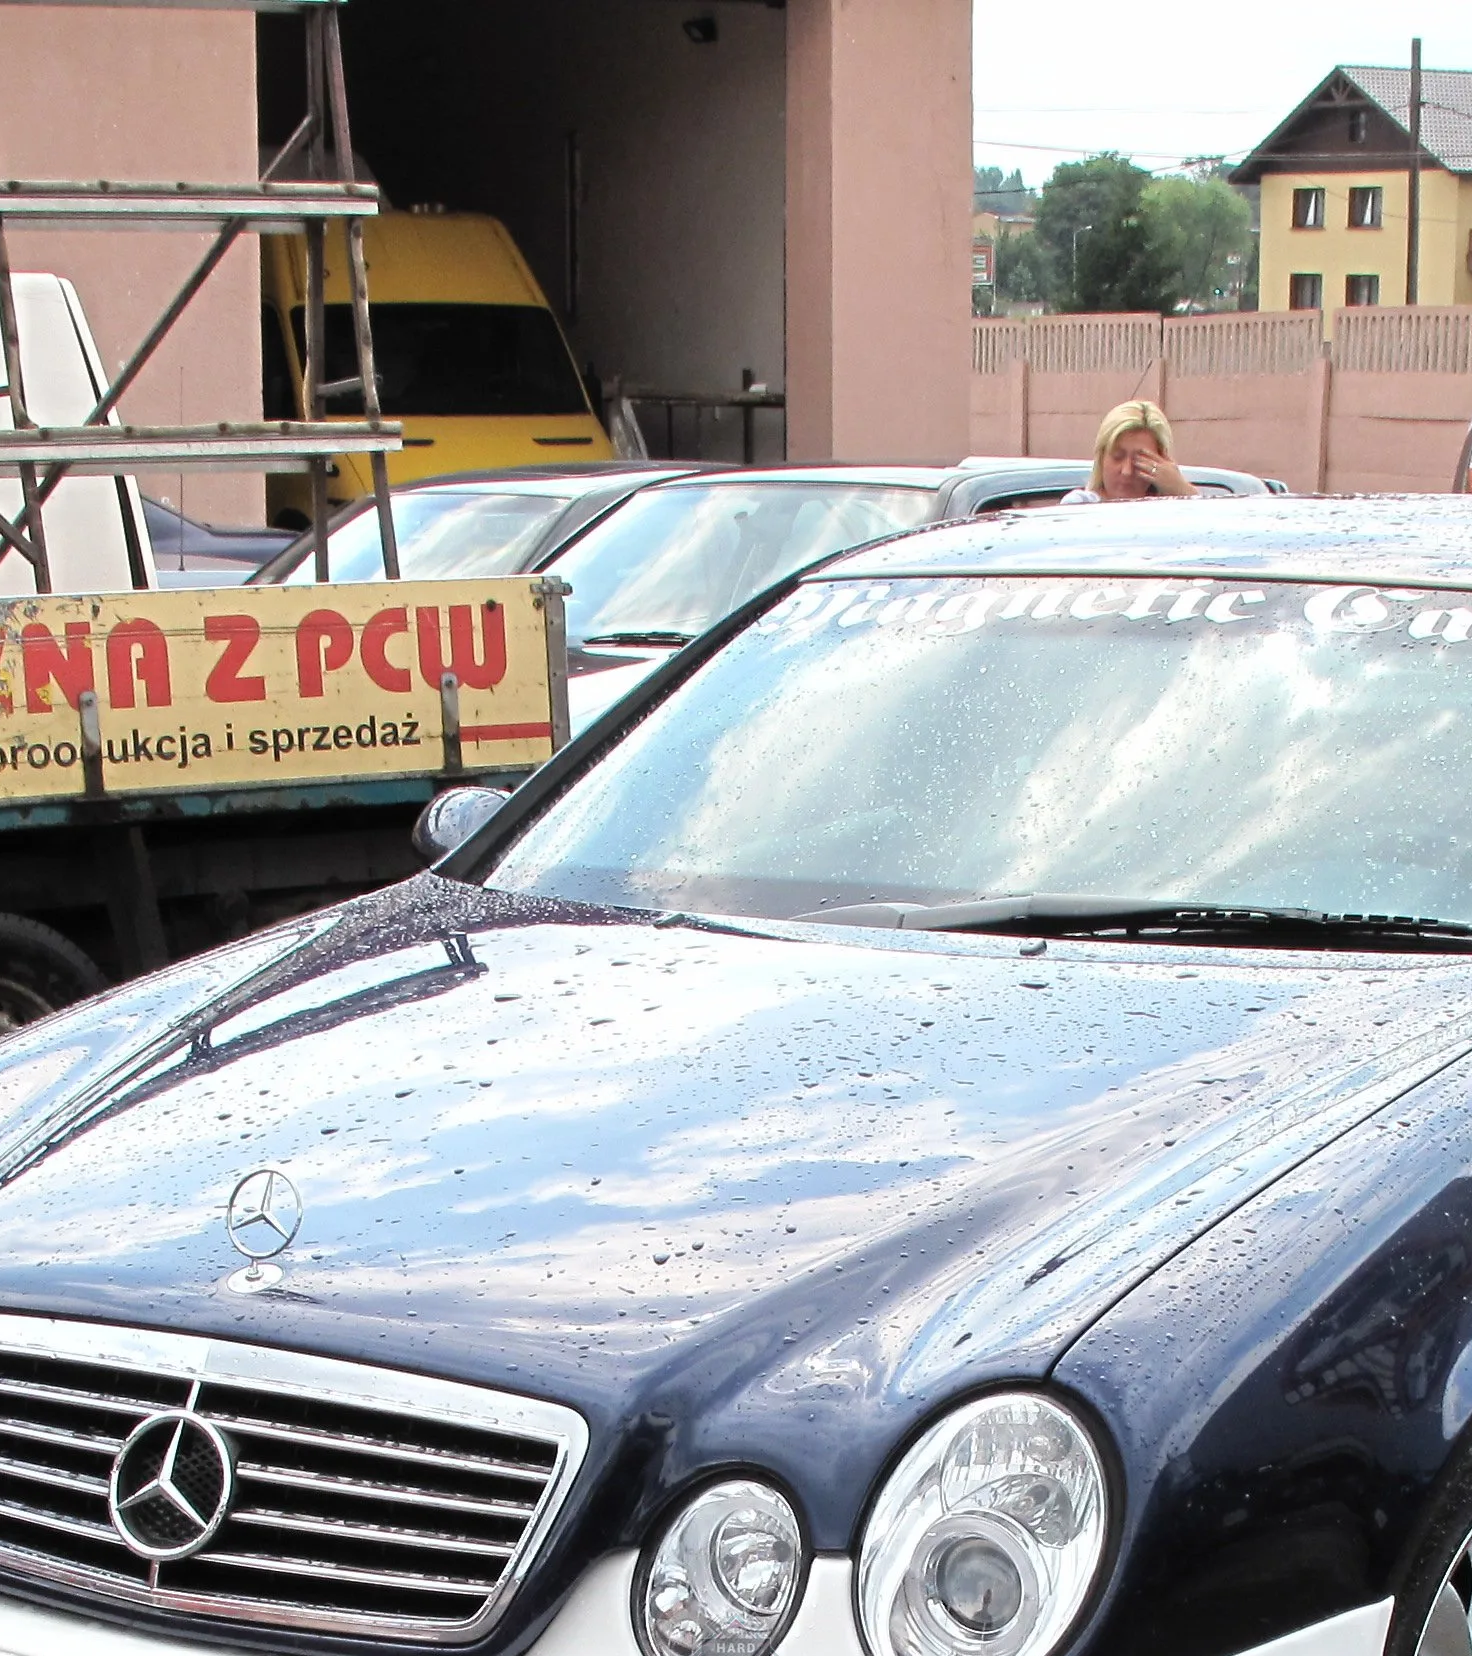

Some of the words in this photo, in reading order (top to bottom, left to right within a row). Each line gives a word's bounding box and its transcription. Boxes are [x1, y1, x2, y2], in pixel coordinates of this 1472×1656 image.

[202, 613, 266, 703] Z
[295, 603, 508, 699] PCW
[225, 723, 234, 751] i
[248, 712, 421, 762] sprzedaż
